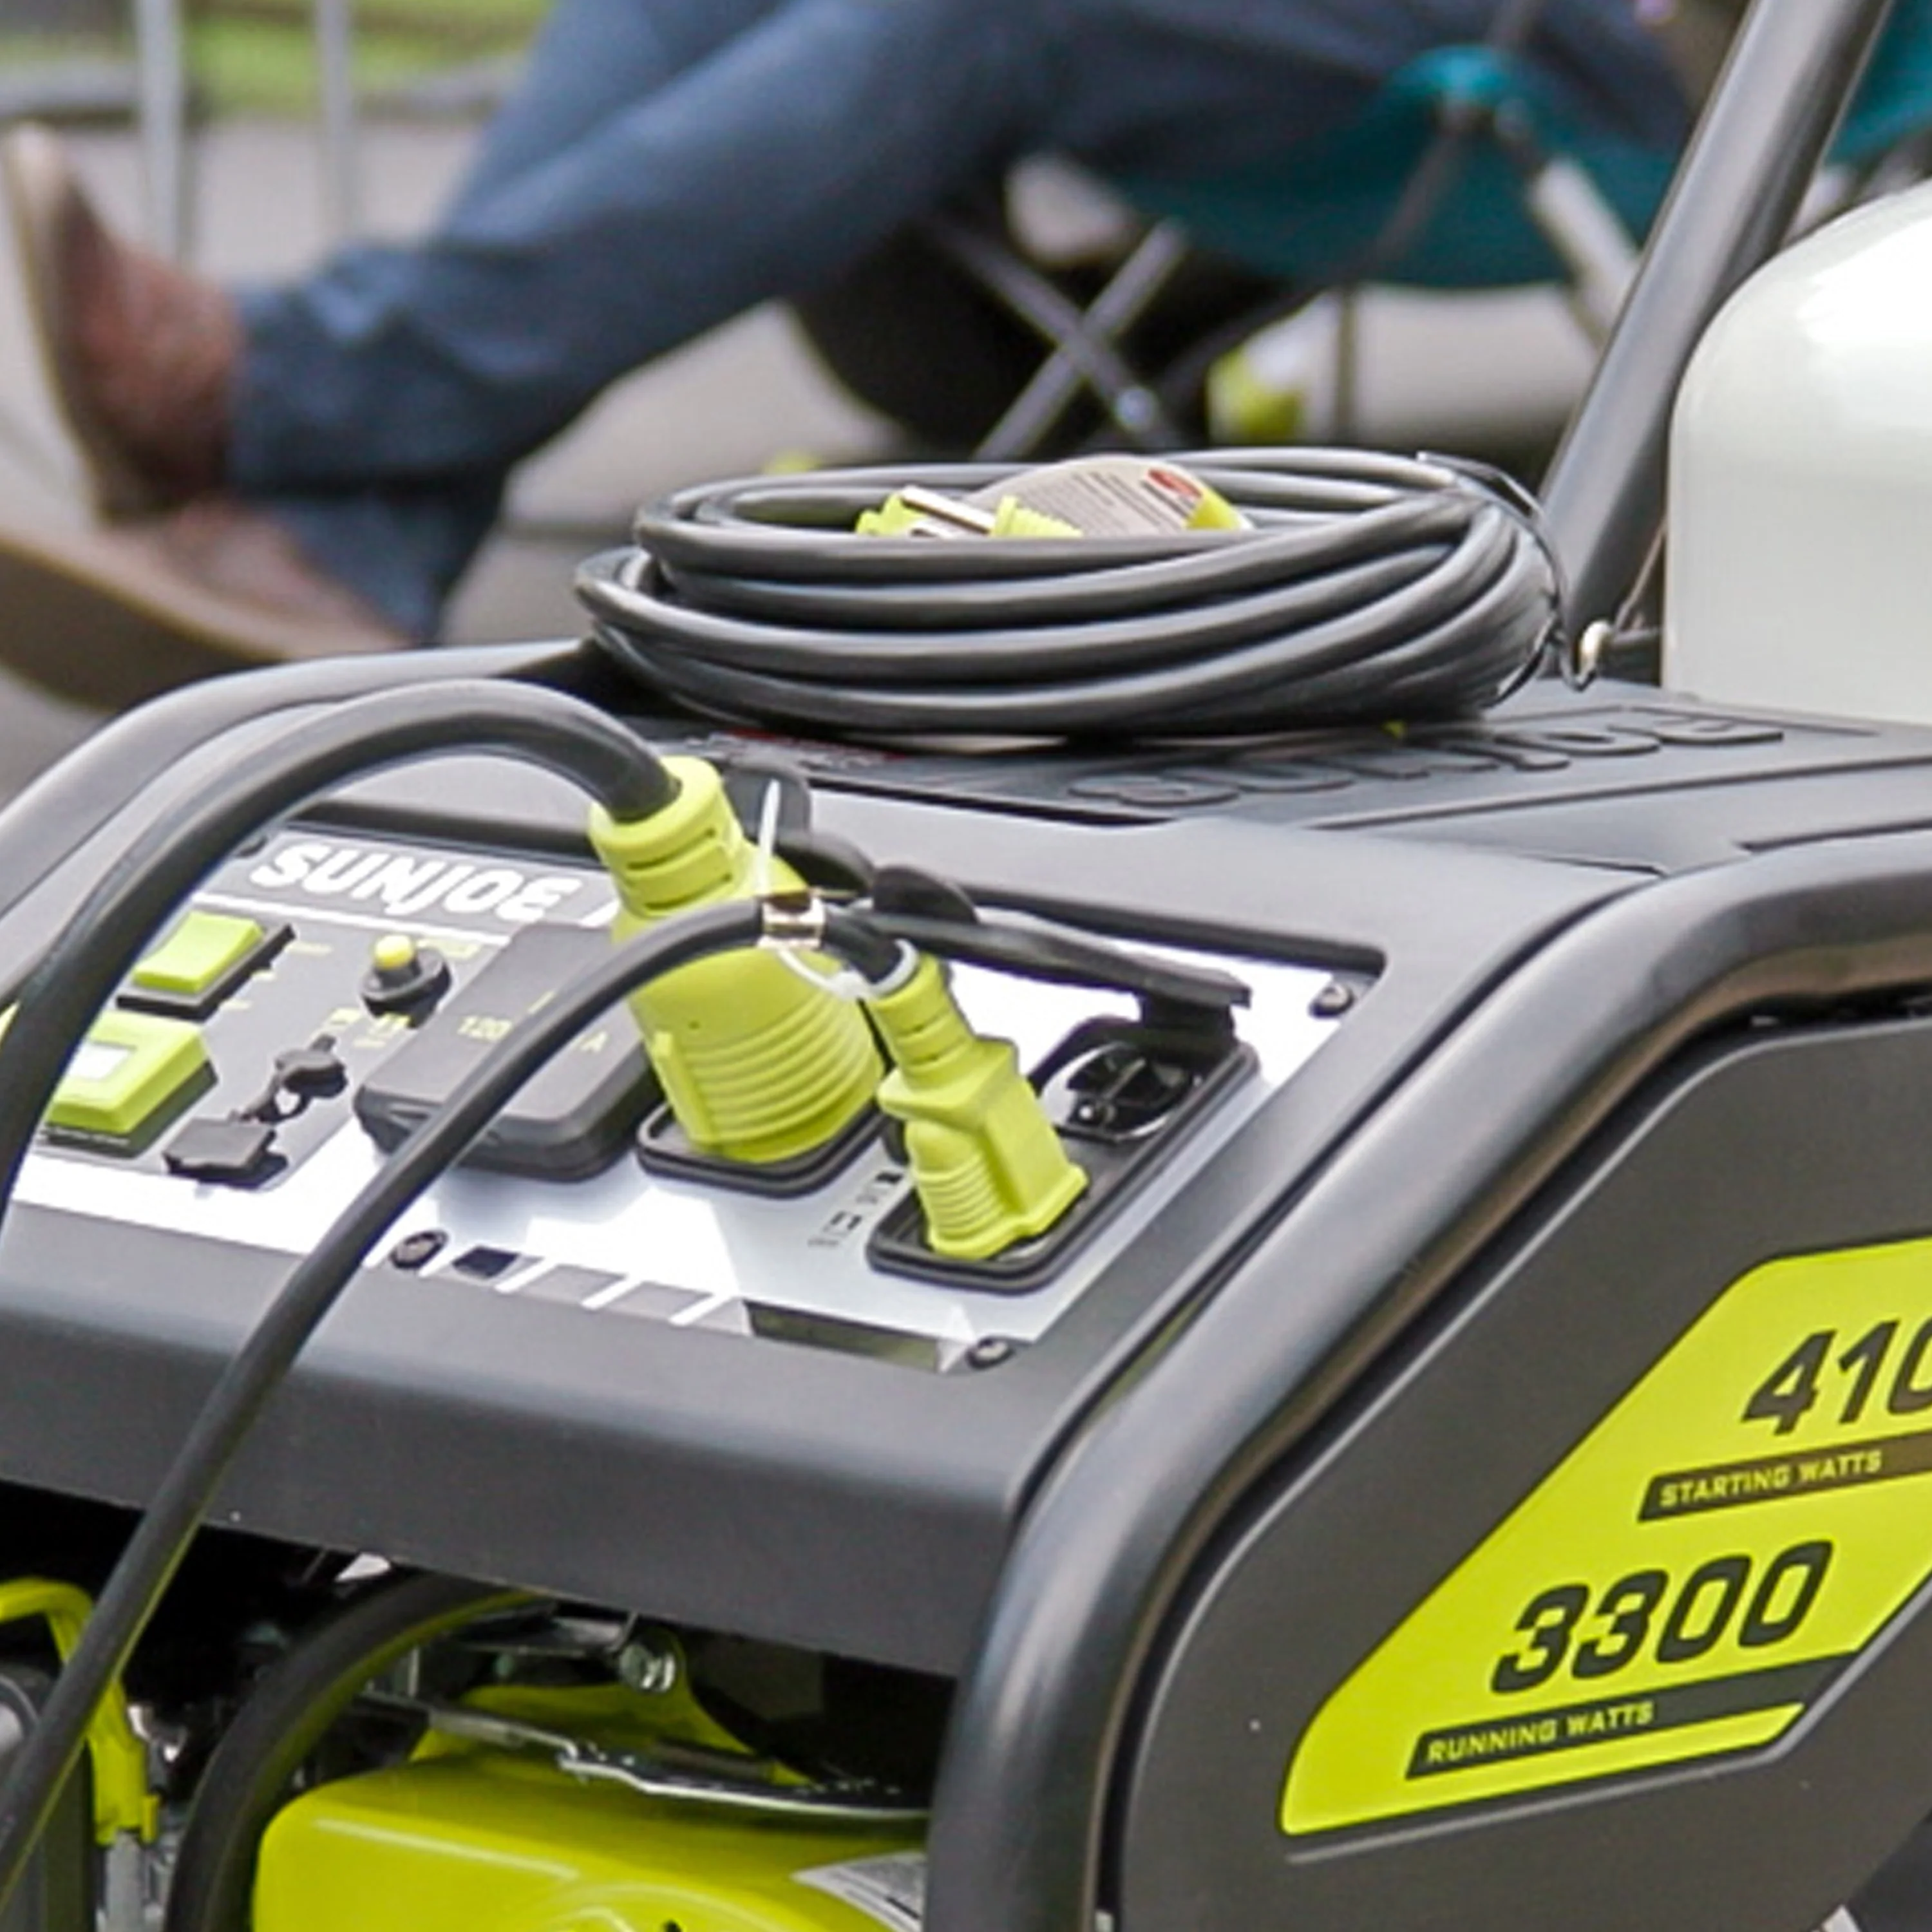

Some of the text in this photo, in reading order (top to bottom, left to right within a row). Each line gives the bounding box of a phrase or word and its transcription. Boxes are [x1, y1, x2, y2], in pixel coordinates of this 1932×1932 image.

[250, 843, 581, 922] SUNJOE
[1659, 1450, 1882, 1508] STARTING WATTS
[1491, 1540, 1833, 1694] 3300
[1426, 1700, 1655, 1763] RUNNING WATTS
